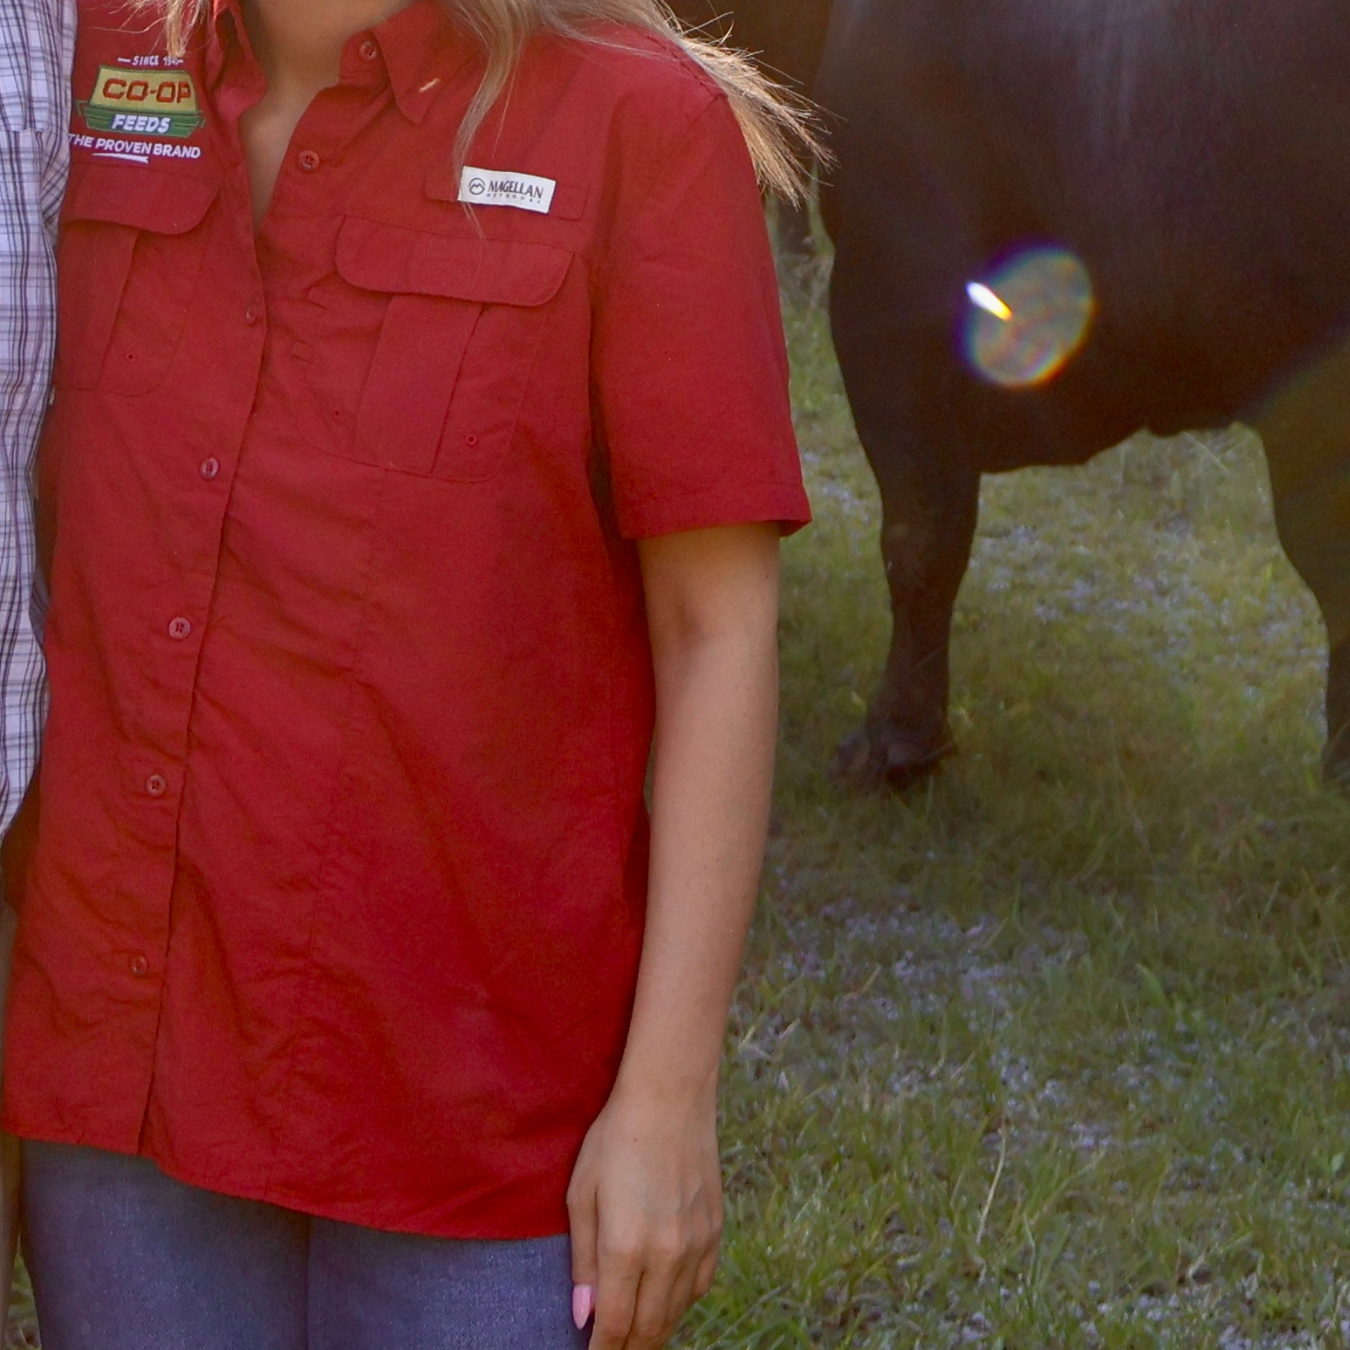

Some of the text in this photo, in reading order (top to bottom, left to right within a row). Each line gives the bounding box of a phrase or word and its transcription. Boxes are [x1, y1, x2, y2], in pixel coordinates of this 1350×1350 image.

[132, 54, 159, 66] SINCE
[102, 78, 191, 104] CO-OP
[111, 113, 171, 134] FEEDS
[68, 133, 201, 159] THE PROVEN BRAND
[488, 180, 544, 200] MAGELLAN
